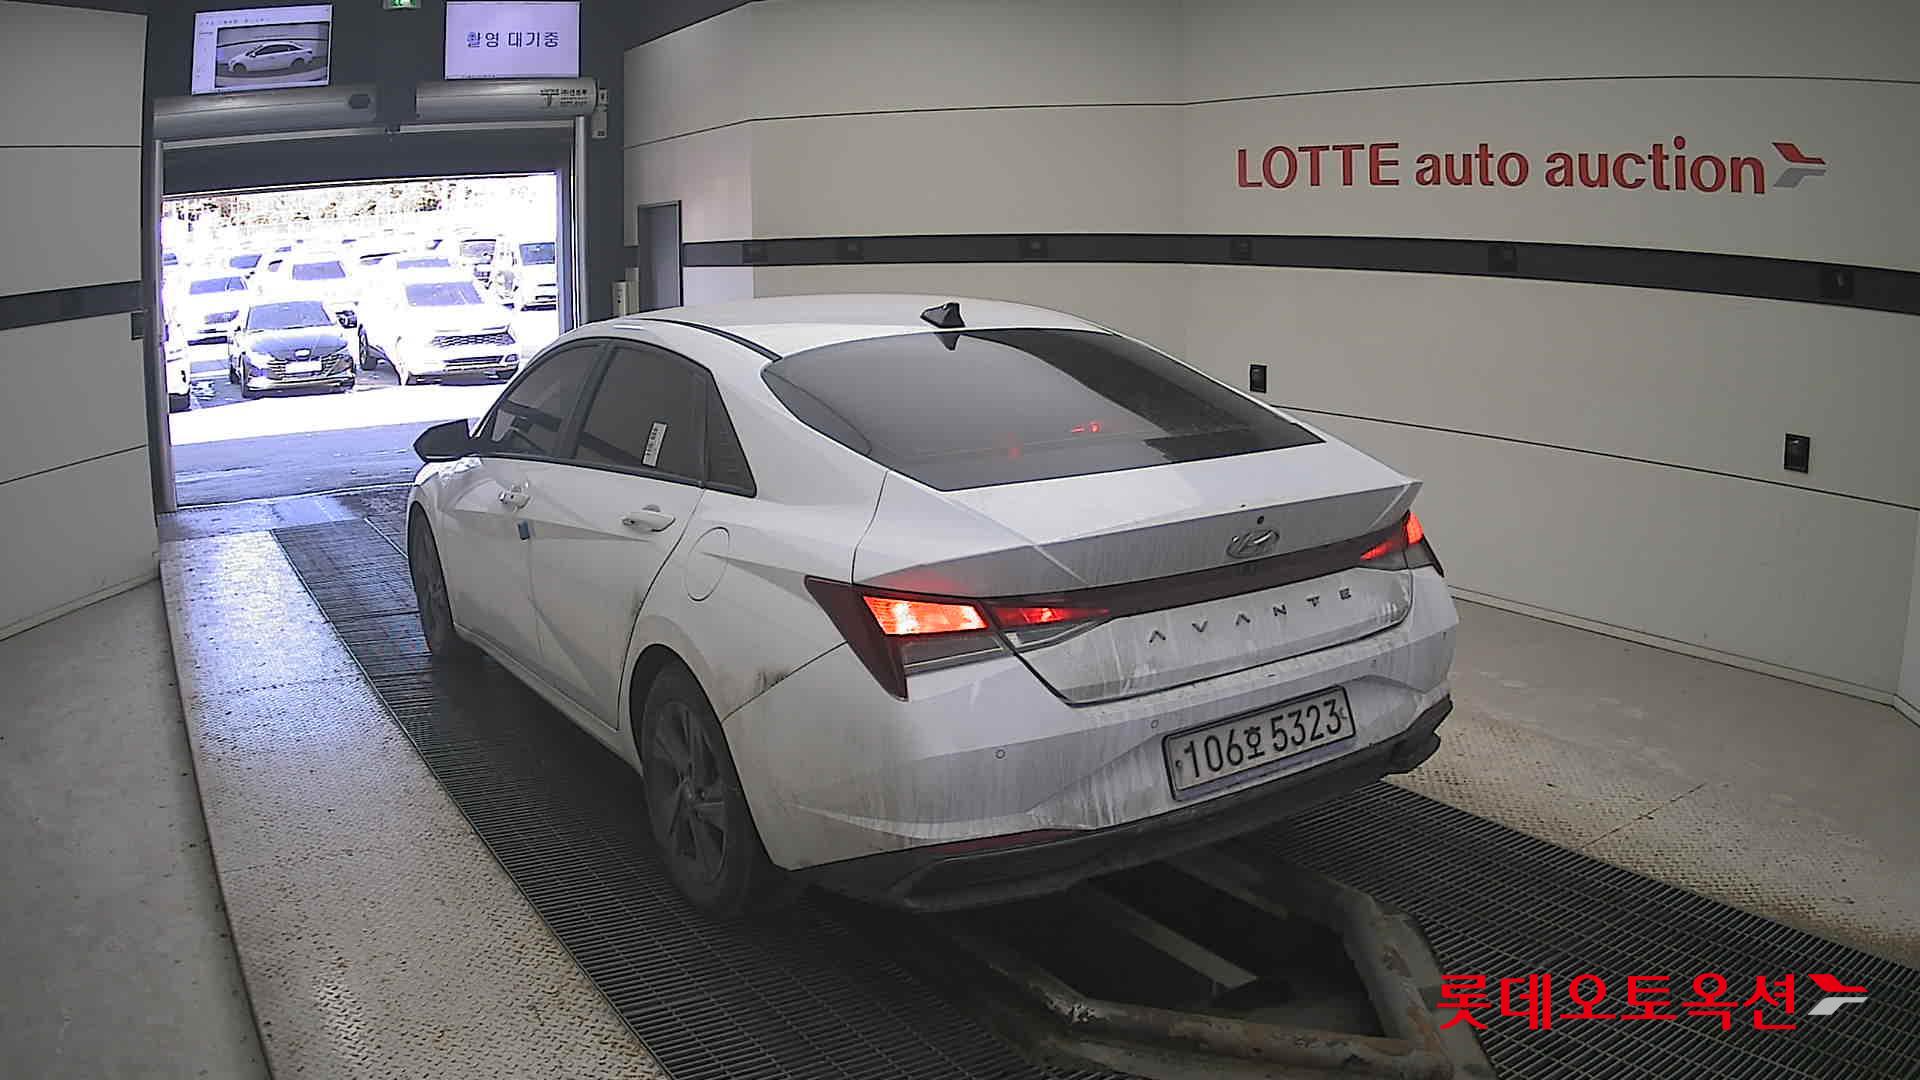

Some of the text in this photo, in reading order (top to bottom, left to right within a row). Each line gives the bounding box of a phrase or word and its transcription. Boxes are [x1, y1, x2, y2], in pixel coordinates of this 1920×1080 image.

[508, 31, 559, 48] 대기중
[1237, 136, 1766, 194] LOTTE auto auction
[1149, 587, 1352, 643] AVANTE
